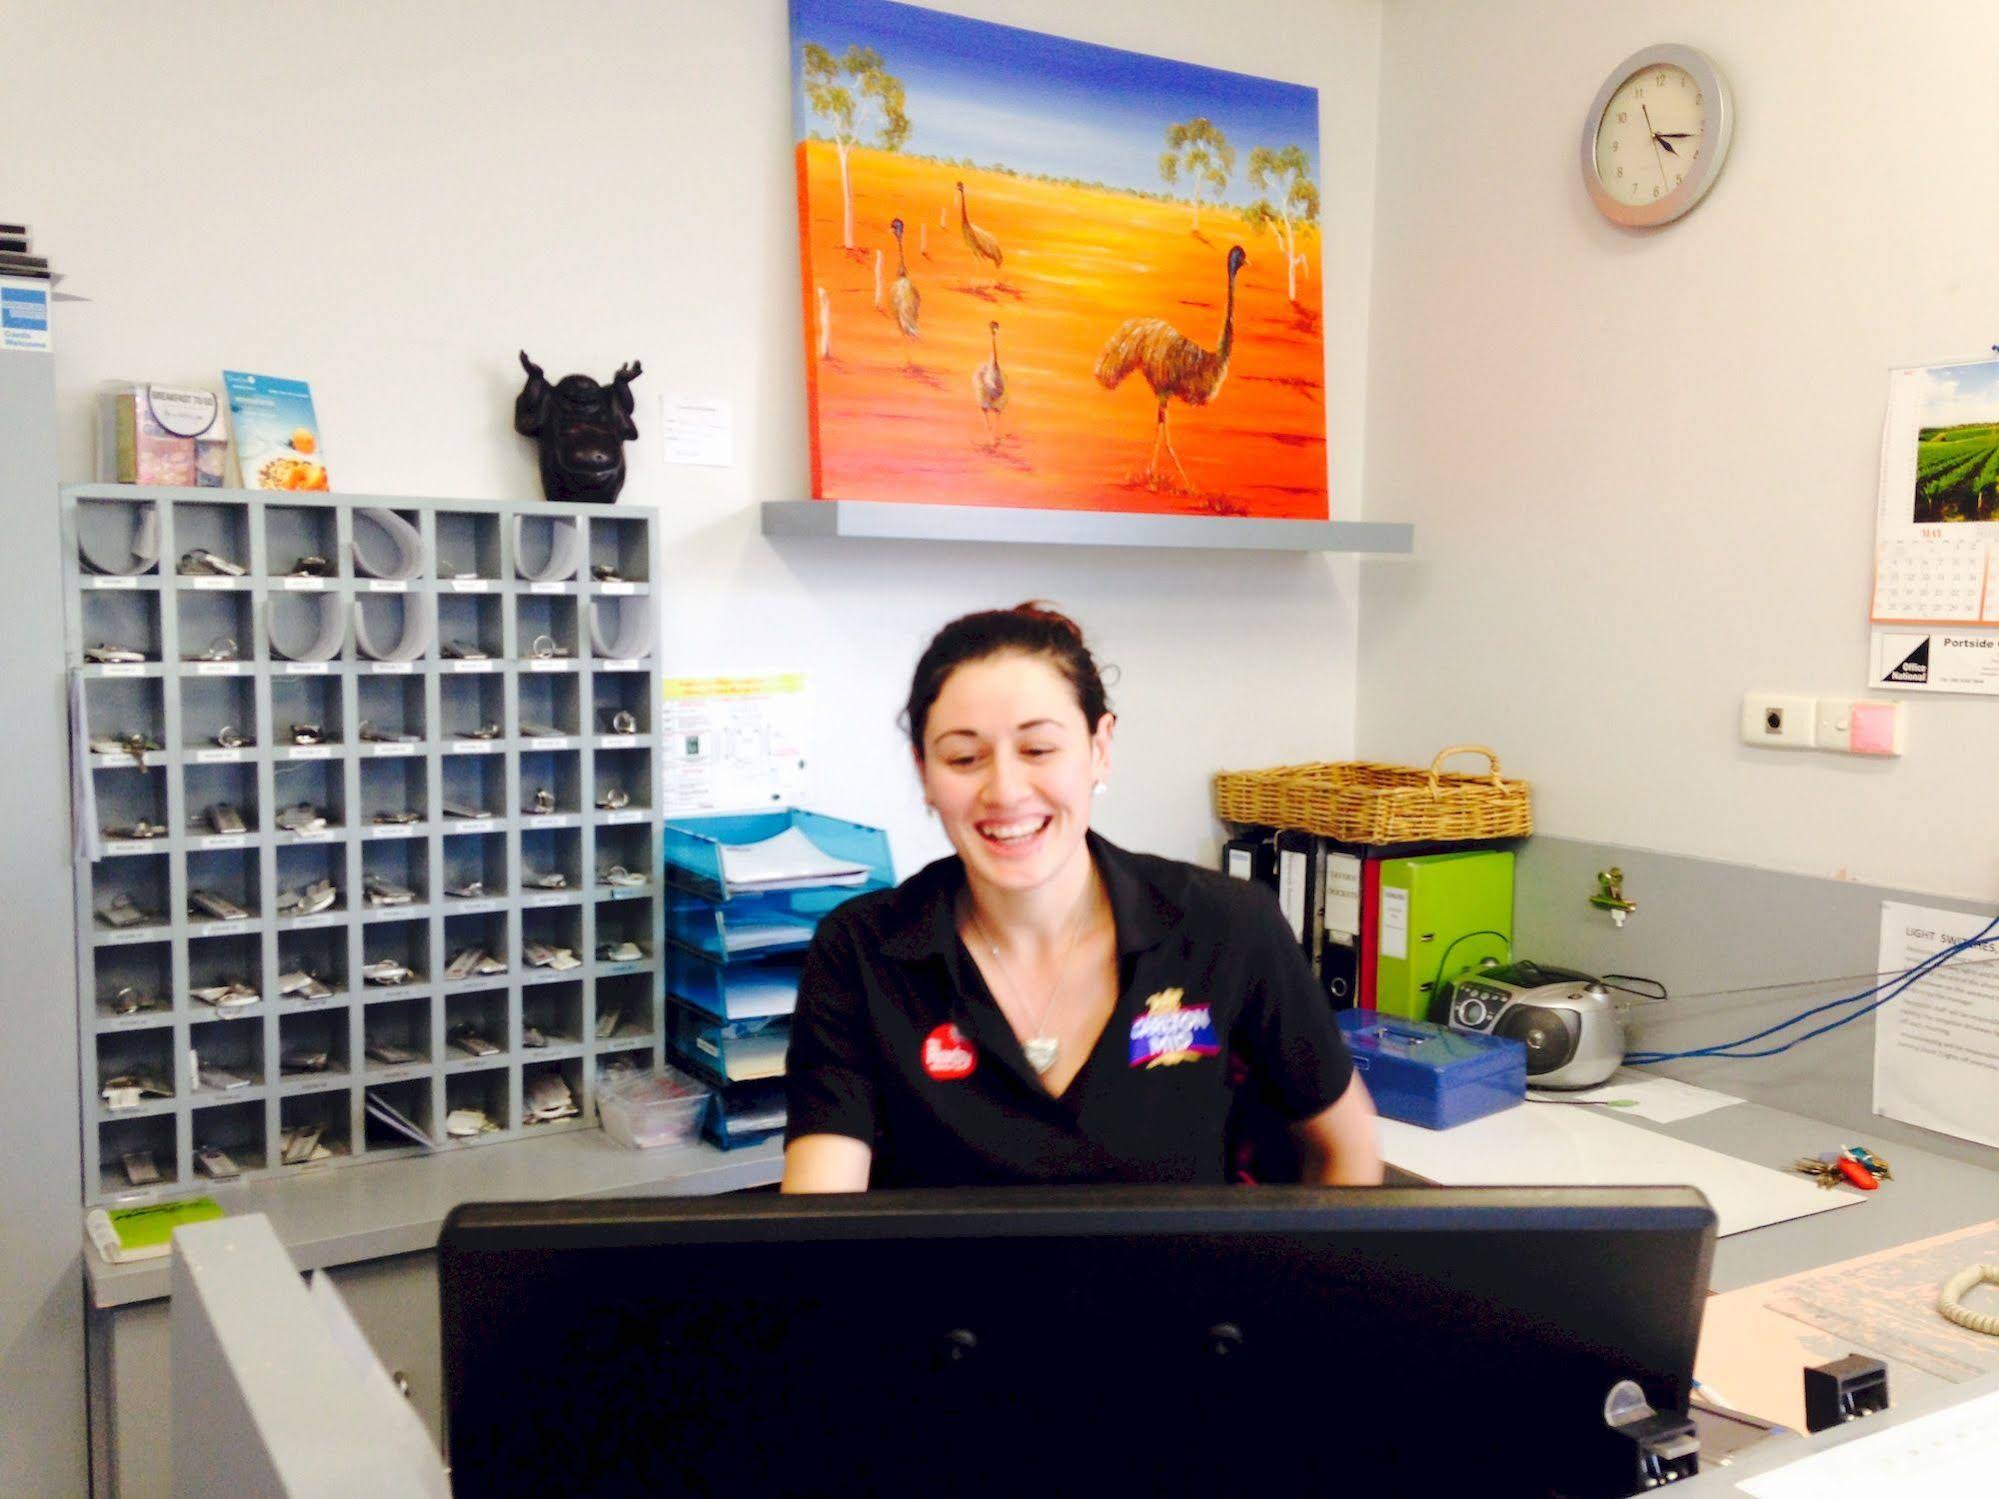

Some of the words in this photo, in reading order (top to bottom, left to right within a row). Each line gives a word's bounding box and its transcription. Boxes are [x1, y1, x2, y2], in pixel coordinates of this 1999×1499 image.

[1656, 72, 1665, 87] 12
[1634, 87, 1643, 99] 11
[1616, 111, 1628, 124] 10
[1631, 182, 1639, 194] 7
[1652, 185, 1660, 197] 6
[1943, 637, 1994, 649] Portside
[1902, 661, 1927, 672] Office
[1891, 671, 1926, 680] National
[1905, 927, 1935, 940] LIGHT
